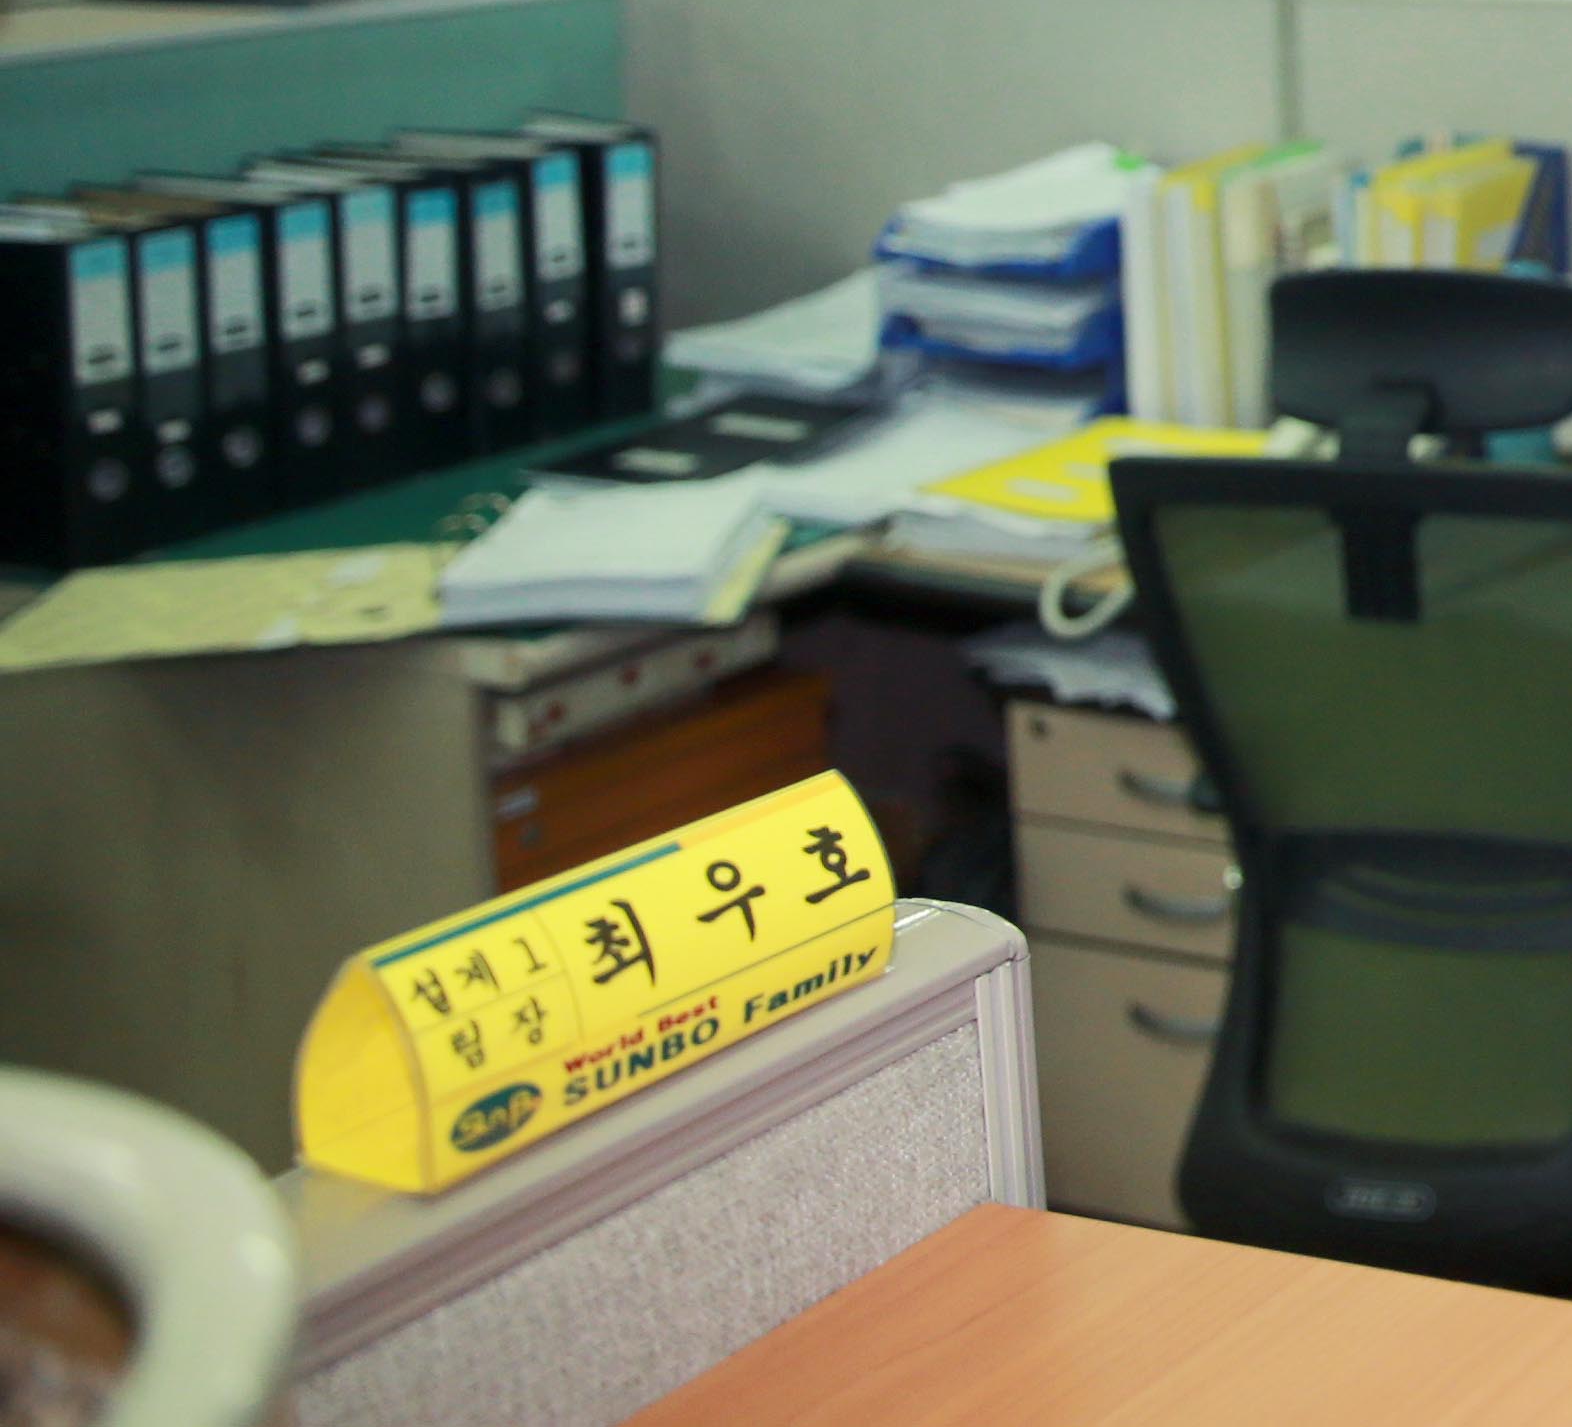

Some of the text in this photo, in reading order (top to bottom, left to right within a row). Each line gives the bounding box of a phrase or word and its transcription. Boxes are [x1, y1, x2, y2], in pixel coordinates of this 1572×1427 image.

[563, 946, 878, 1107] SUNBO Family
[564, 995, 720, 1074] World Best
